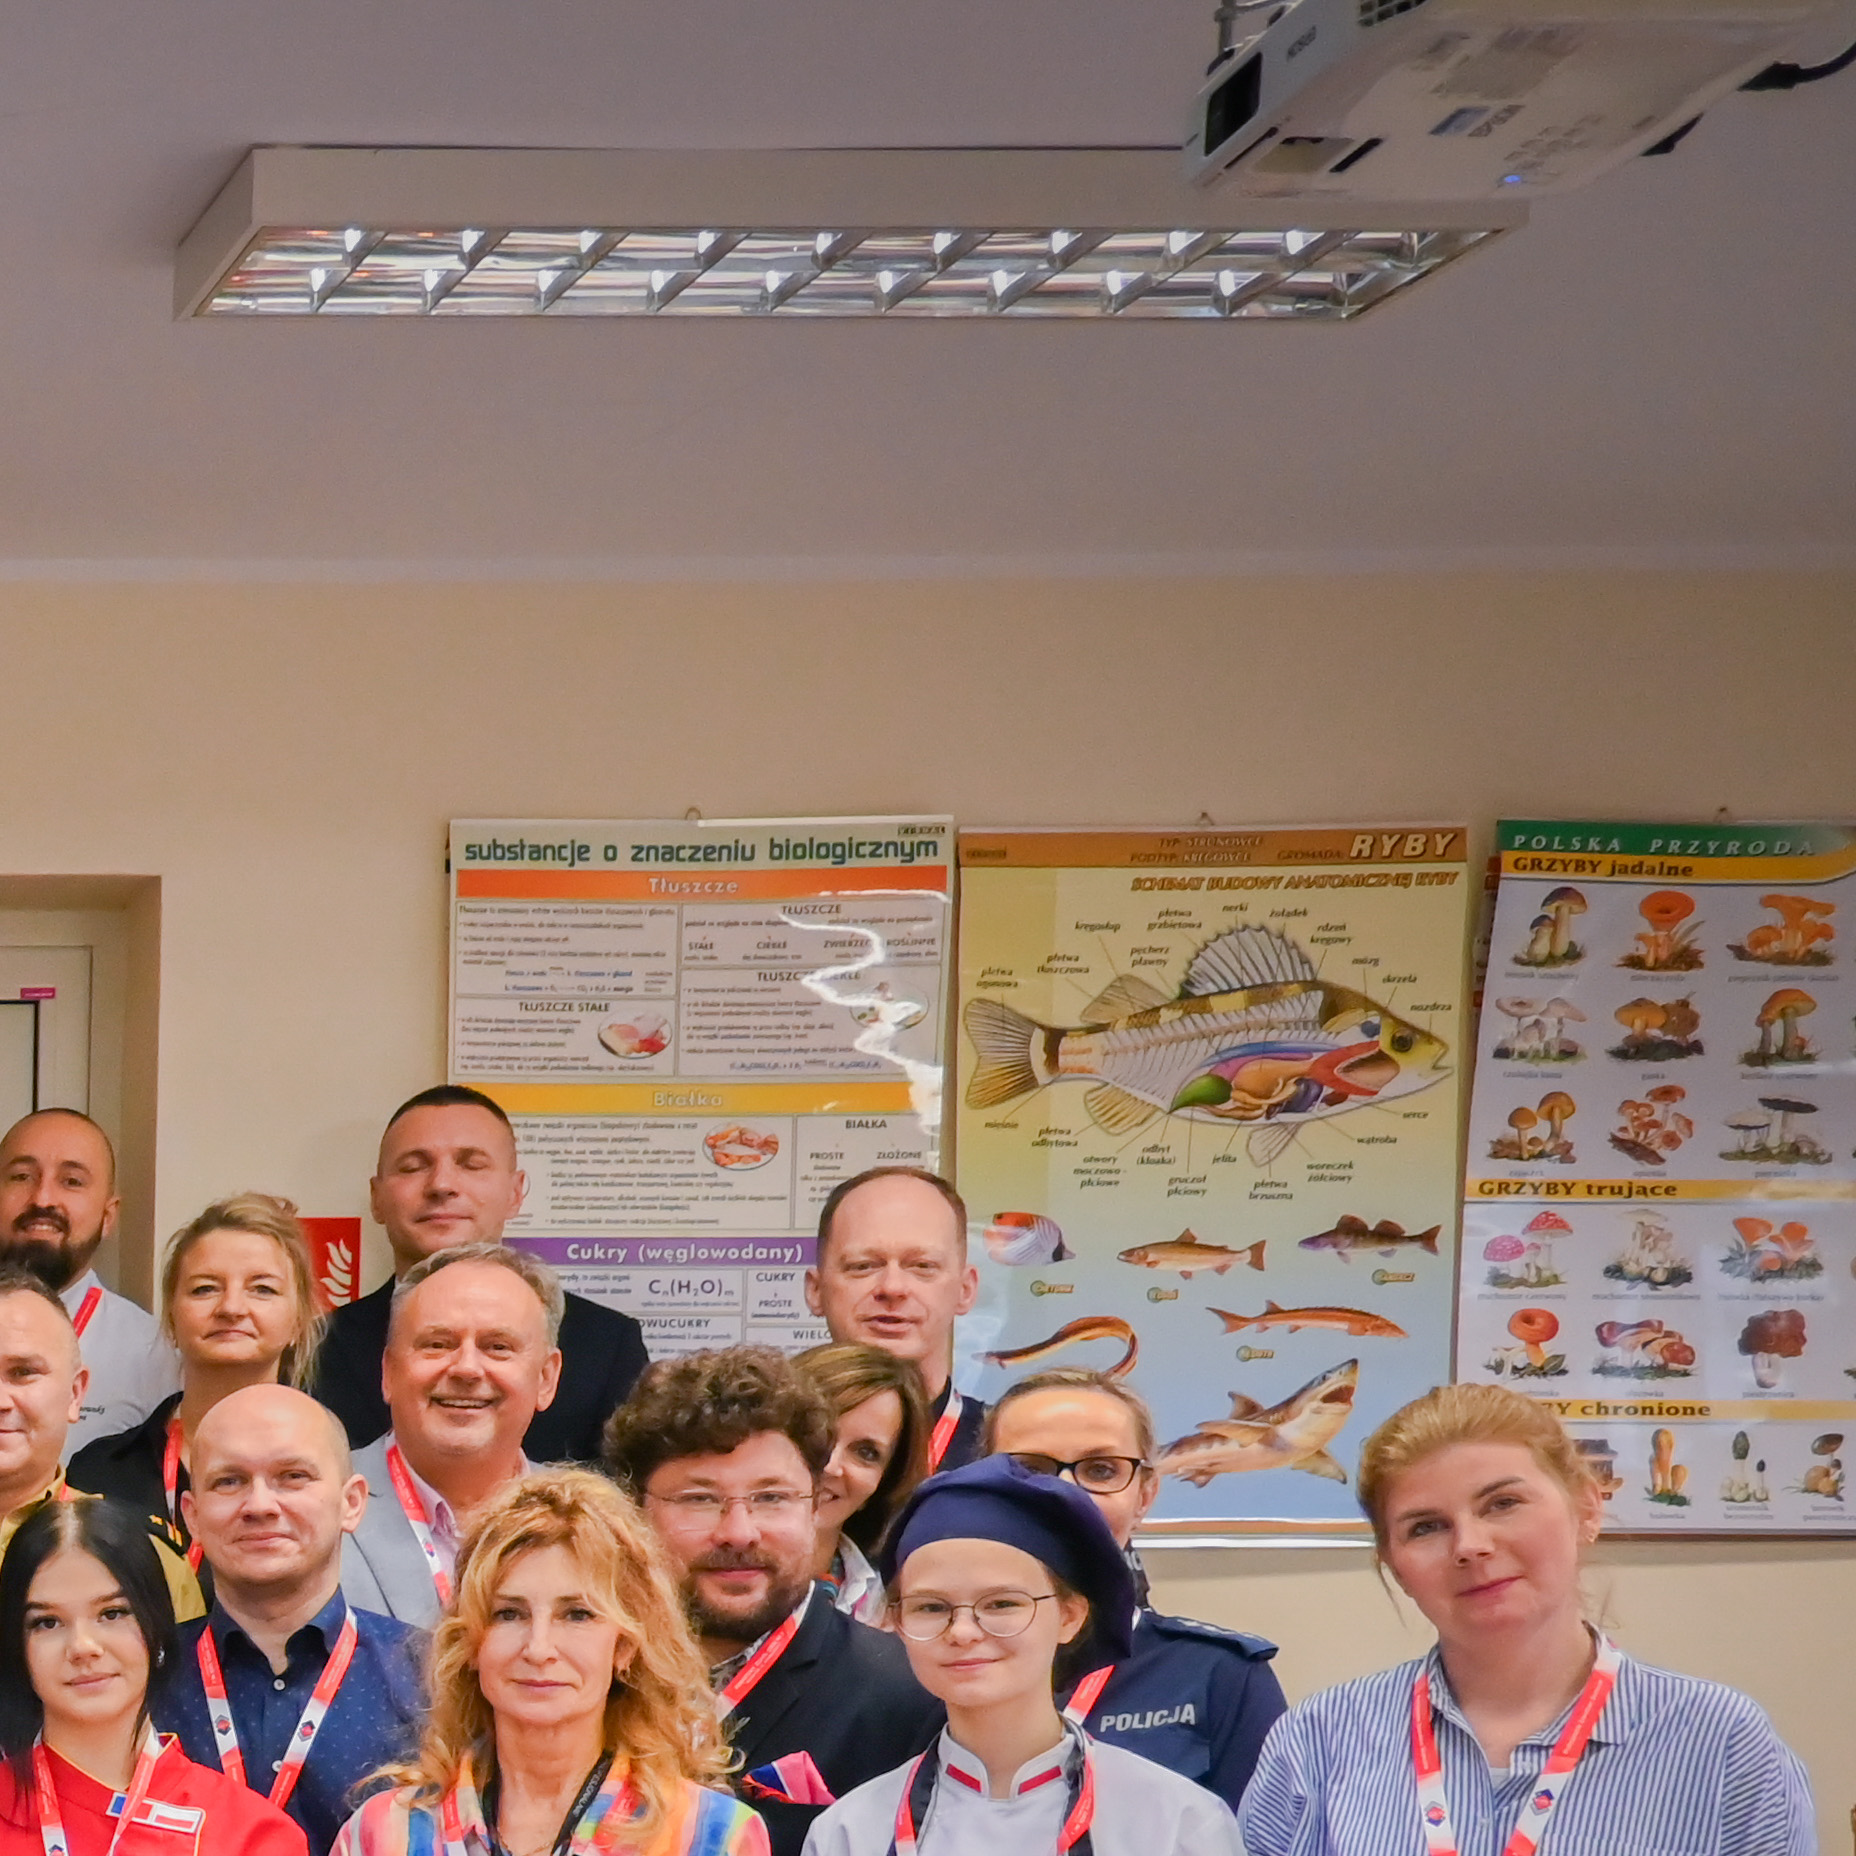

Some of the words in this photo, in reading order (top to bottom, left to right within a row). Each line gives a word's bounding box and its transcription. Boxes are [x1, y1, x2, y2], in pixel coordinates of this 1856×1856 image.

[464, 838, 591, 867] substancje
[603, 844, 618, 862] o
[630, 841, 756, 863] znaczeniu
[768, 837, 939, 865] biologicznym
[1349, 833, 1457, 859] RYBY
[1512, 835, 1622, 852] POLSKA
[1649, 838, 1817, 856] PRZYRODA
[1512, 856, 1602, 873] GRZYBY
[1609, 860, 1694, 878] jadalne
[647, 877, 738, 895] Tłuszcze
[1207, 875, 1282, 890] BUDOWY
[1284, 872, 1412, 890] ANATOMICZNEJ
[1414, 871, 1459, 887] RYBY
[1222, 903, 1248, 913] nerki
[653, 1090, 723, 1107] Białka
[1478, 1181, 1577, 1197] GRZYBY
[1586, 1181, 1678, 1199] trujące
[566, 1243, 628, 1264] Cukry
[638, 1242, 803, 1266] (węglowodany)
[756, 1272, 795, 1282] CUKRY
[1580, 1402, 1711, 1417] chronione
[1099, 1702, 1196, 1732] POLICJA
